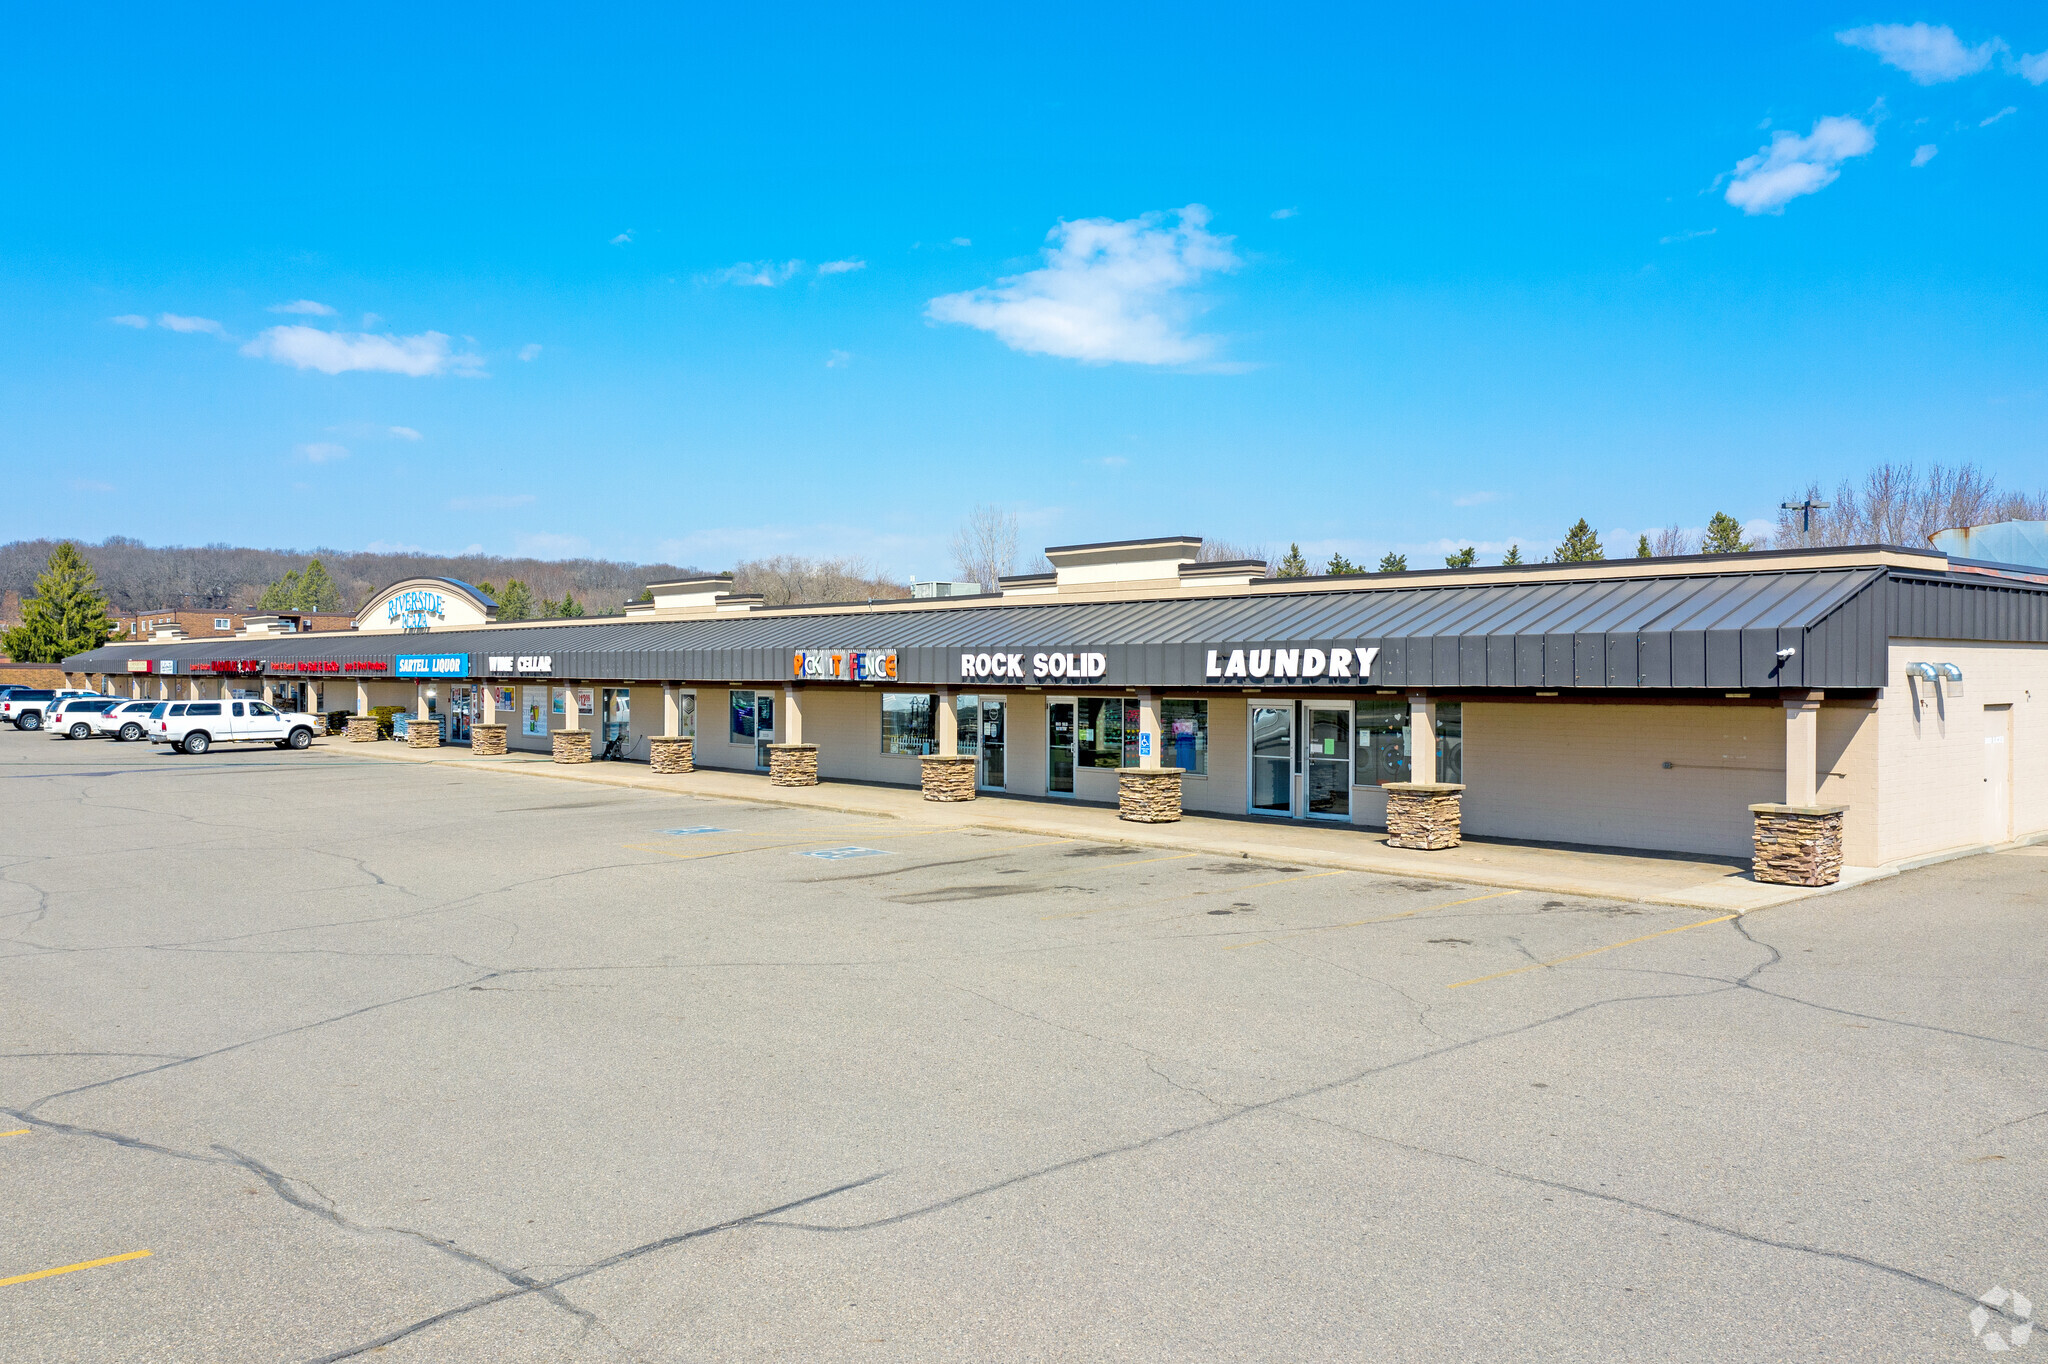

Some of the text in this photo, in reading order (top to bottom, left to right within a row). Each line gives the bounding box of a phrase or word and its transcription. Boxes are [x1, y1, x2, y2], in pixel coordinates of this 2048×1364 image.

[388, 591, 442, 619] RIVERSIDE
[402, 613, 427, 628] PLAZA
[399, 658, 460, 672] SARTELL LIQUOR
[489, 656, 552, 672] WINE CELLAR
[794, 652, 822, 676] PICK
[849, 653, 896, 680] FENCE
[961, 652, 1106, 677] ROCK SOLID
[1206, 647, 1380, 677] LAUNDRY
